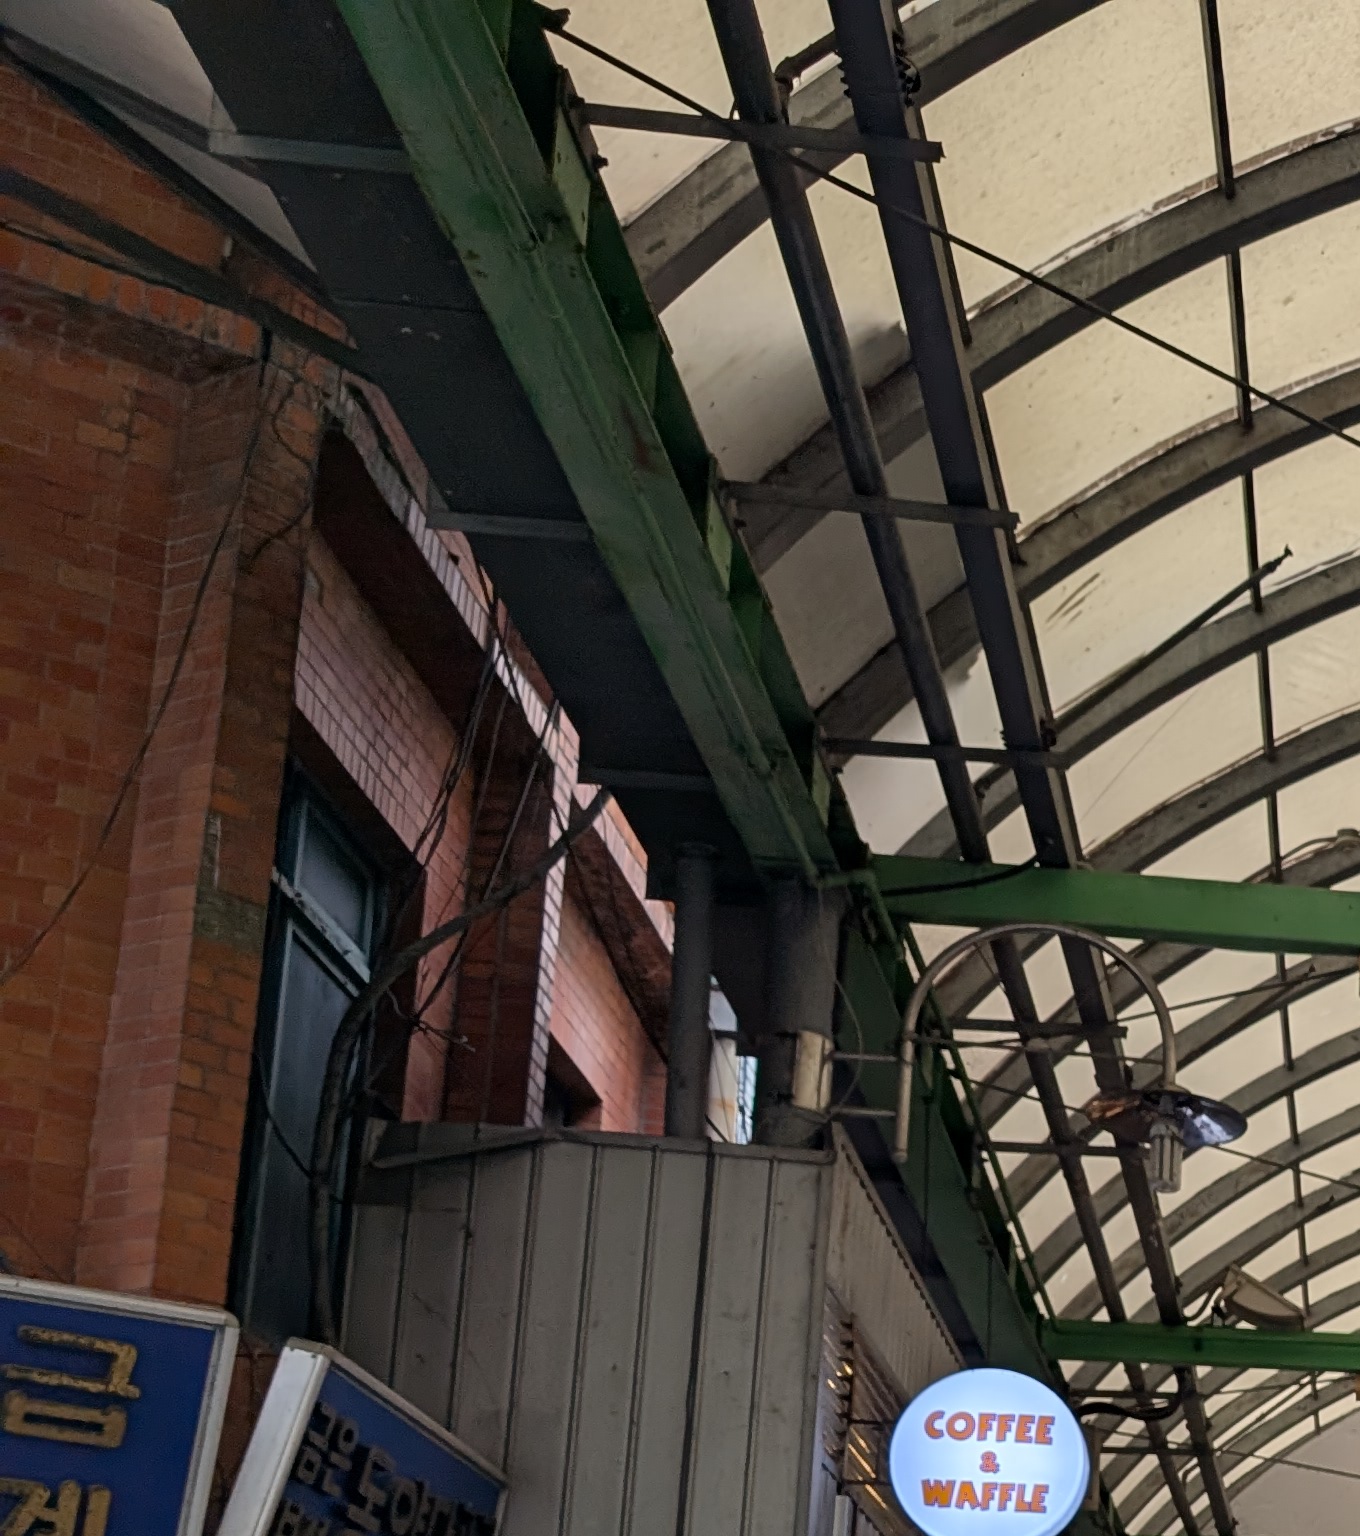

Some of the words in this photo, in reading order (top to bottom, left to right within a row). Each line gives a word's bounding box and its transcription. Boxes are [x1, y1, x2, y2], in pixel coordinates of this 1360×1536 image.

[924, 1410, 1056, 1446] COFFEE
[979, 1451, 1000, 1474] &
[921, 1478, 1050, 1514] WAFFLE
